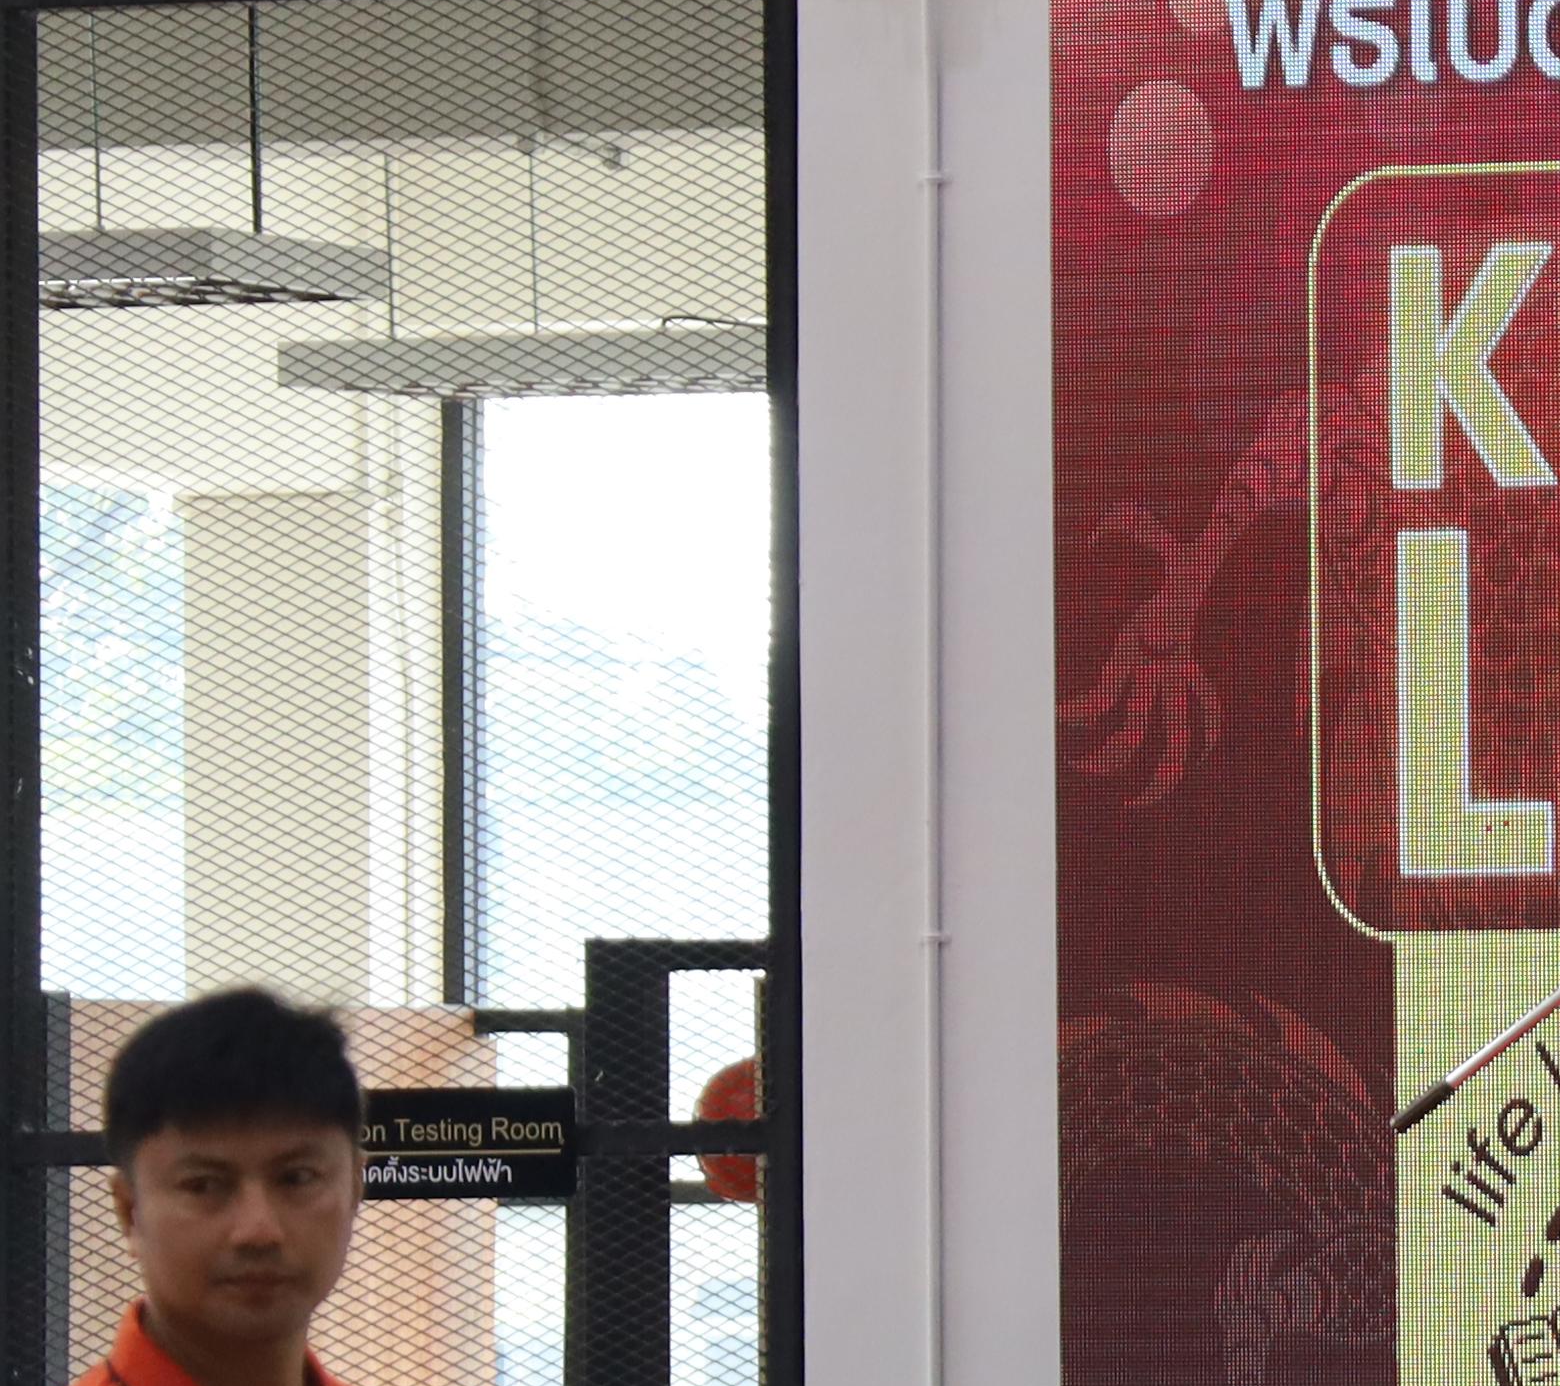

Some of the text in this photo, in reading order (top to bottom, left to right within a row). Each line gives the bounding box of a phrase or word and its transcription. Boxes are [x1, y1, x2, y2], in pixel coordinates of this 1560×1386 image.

[394, 1118, 482, 1147] Testing
[492, 1116, 564, 1144] Room
[1441, 1098, 1543, 1226] life
